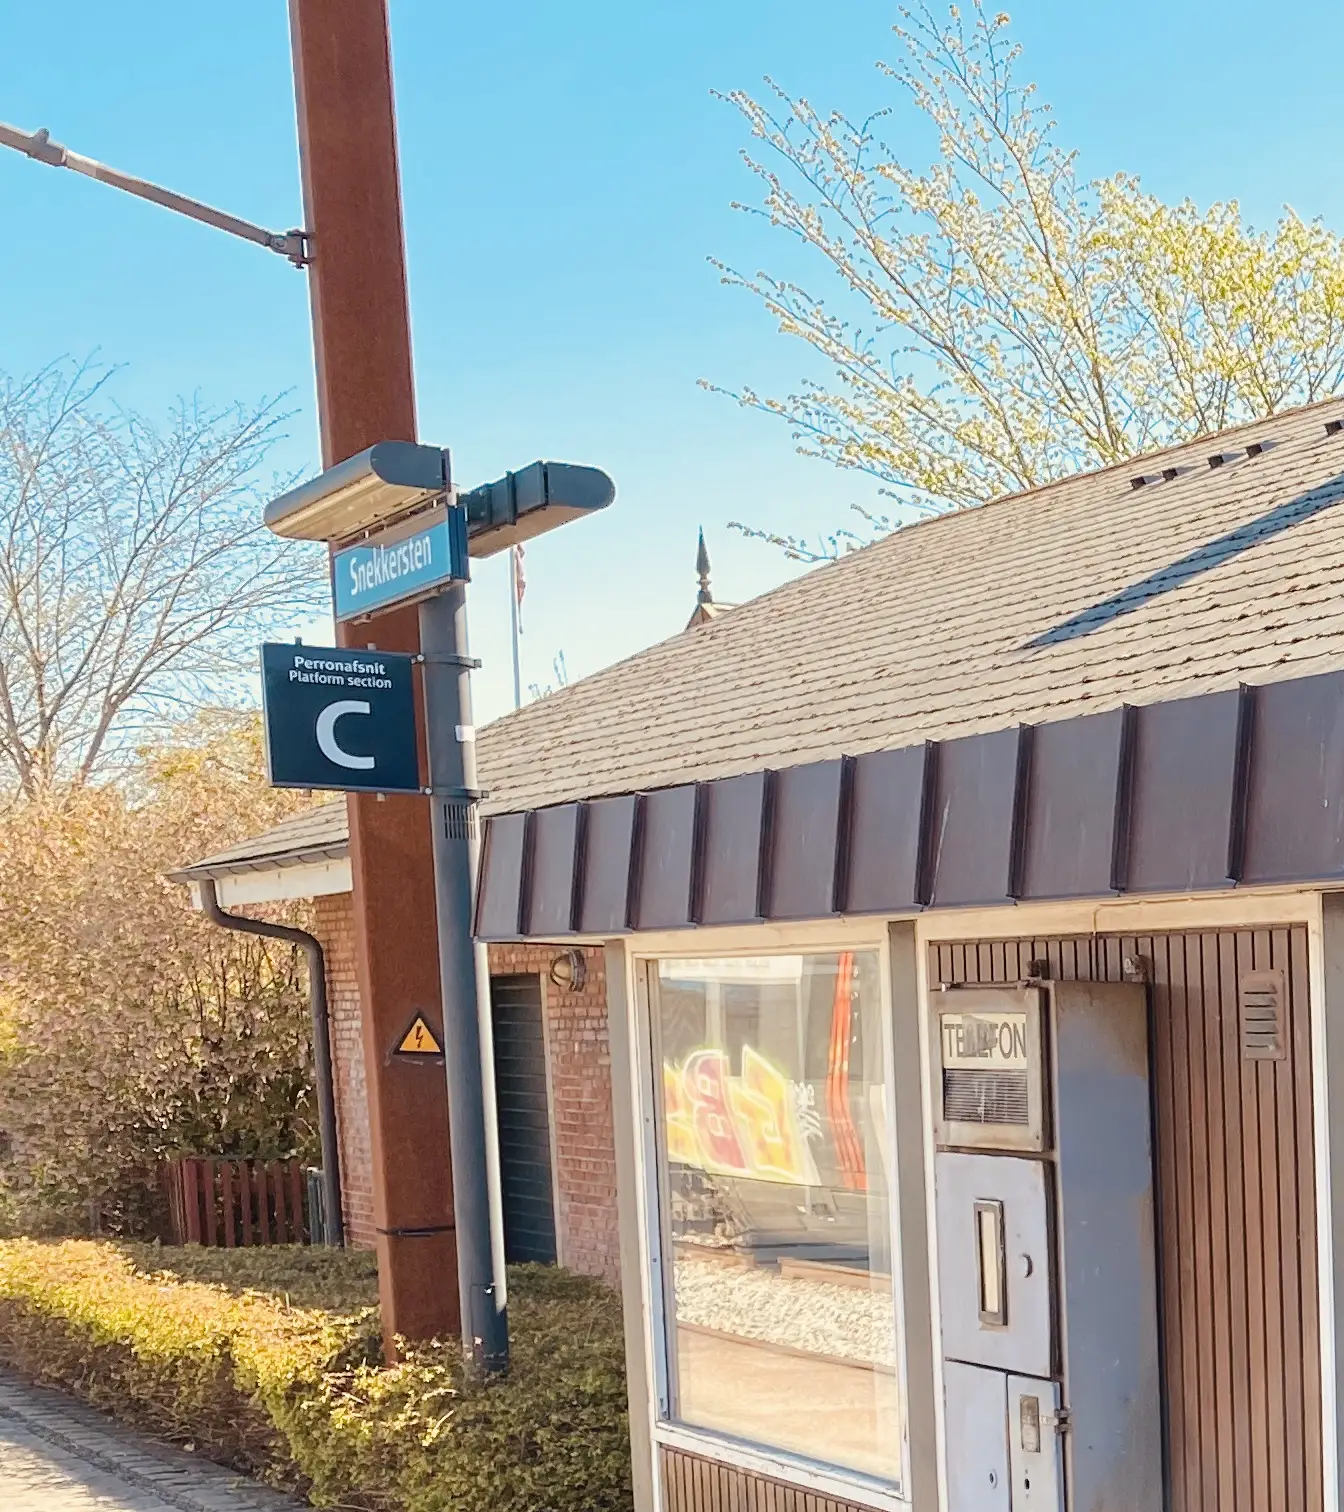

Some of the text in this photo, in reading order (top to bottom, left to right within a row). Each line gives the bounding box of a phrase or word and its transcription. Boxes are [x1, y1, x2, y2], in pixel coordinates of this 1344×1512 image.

[349, 535, 432, 596] Snekkersten
[288, 669, 393, 689] Platform section
[293, 655, 387, 676] Perronafsnit
[315, 700, 376, 770] C
